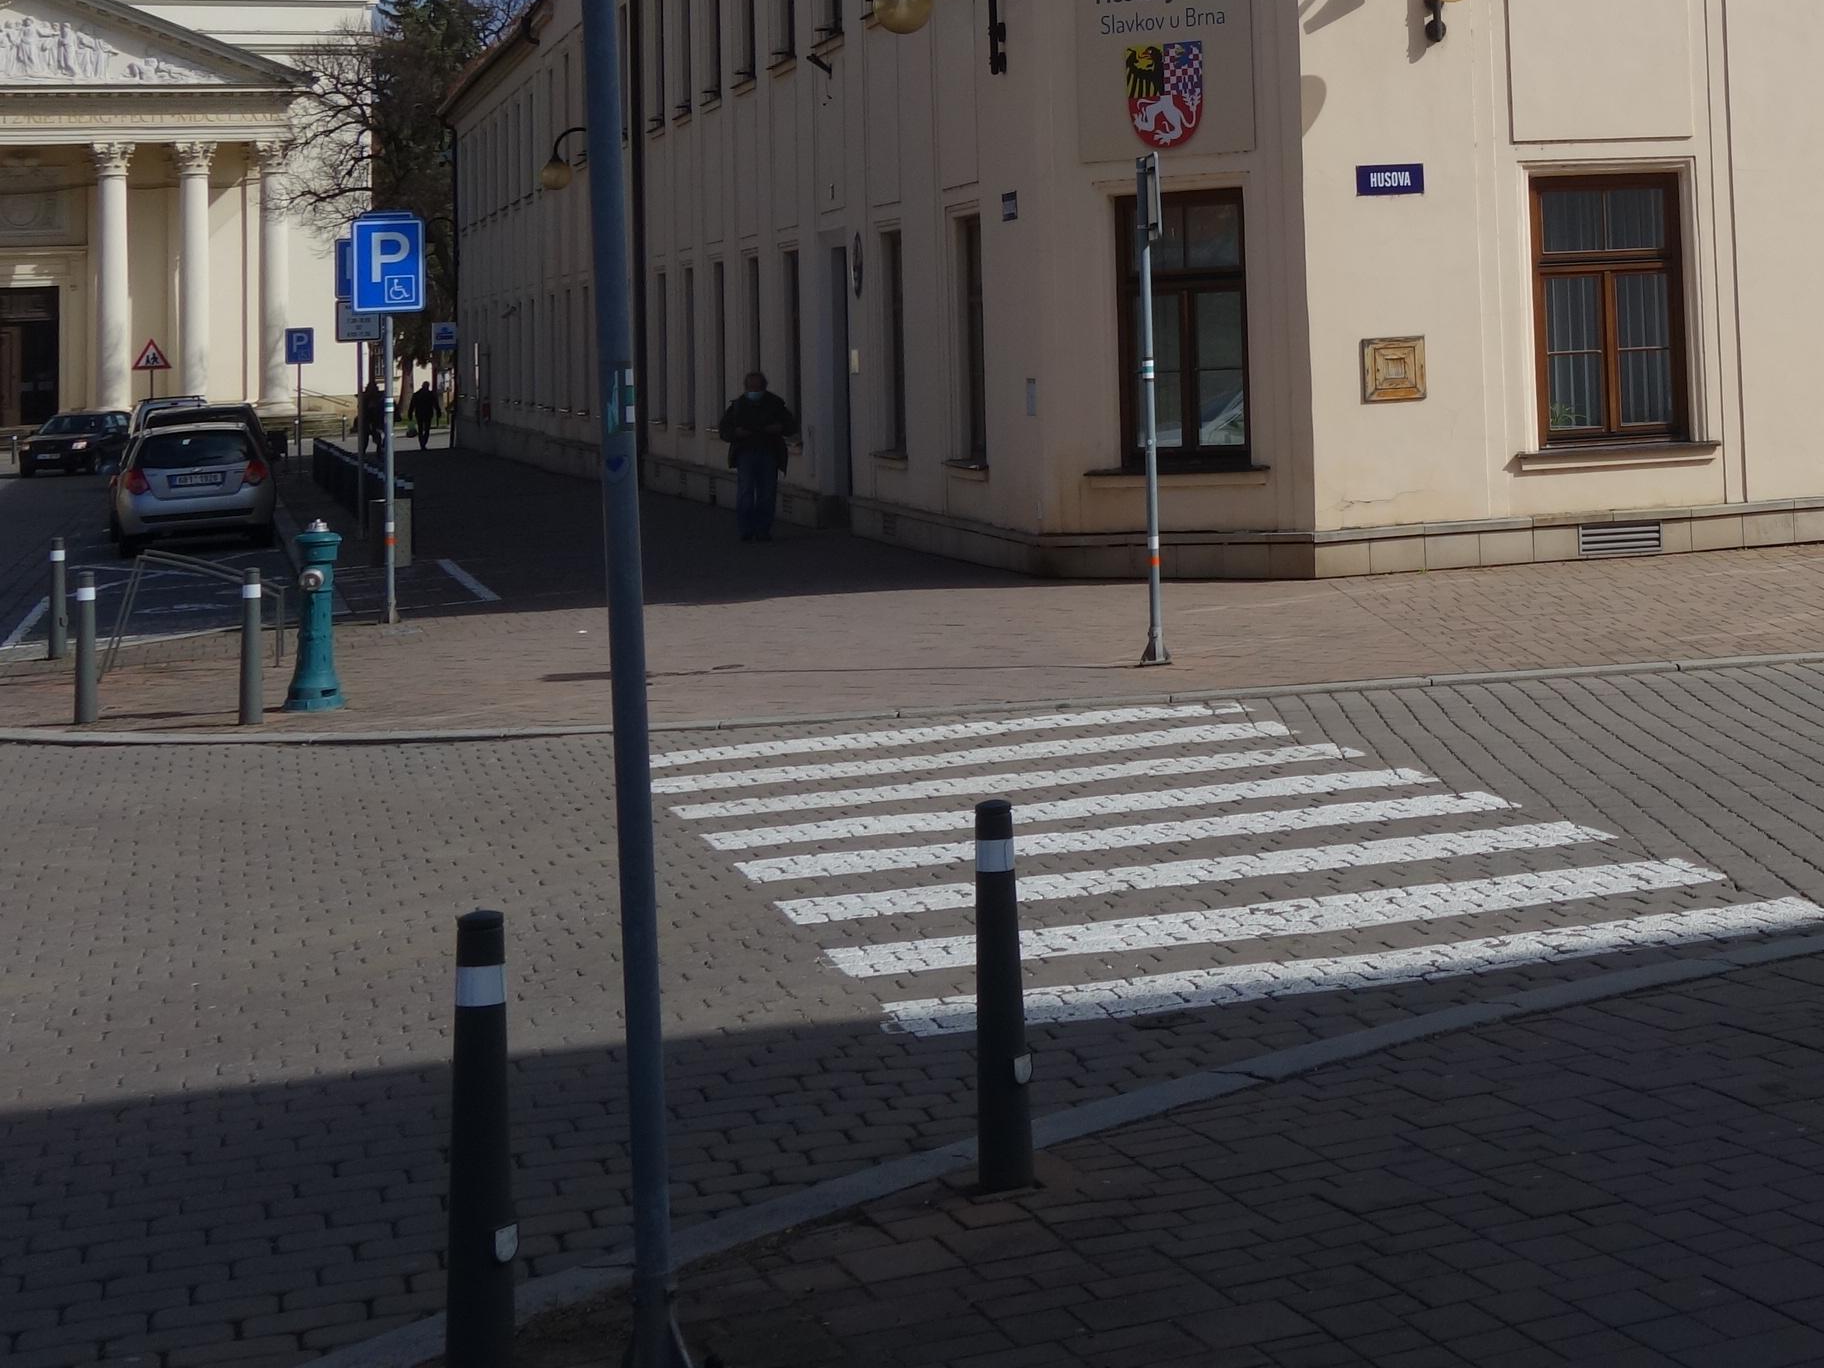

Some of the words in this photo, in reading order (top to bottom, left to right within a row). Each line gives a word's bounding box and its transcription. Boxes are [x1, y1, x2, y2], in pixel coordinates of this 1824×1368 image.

[1100, 12, 1165, 35] Slavkov
[1169, 15, 1180, 29] u
[1185, 7, 1225, 28] Brna
[1370, 171, 1411, 188] HUSOVA
[371, 232, 410, 283] P
[292, 332, 309, 353] P
